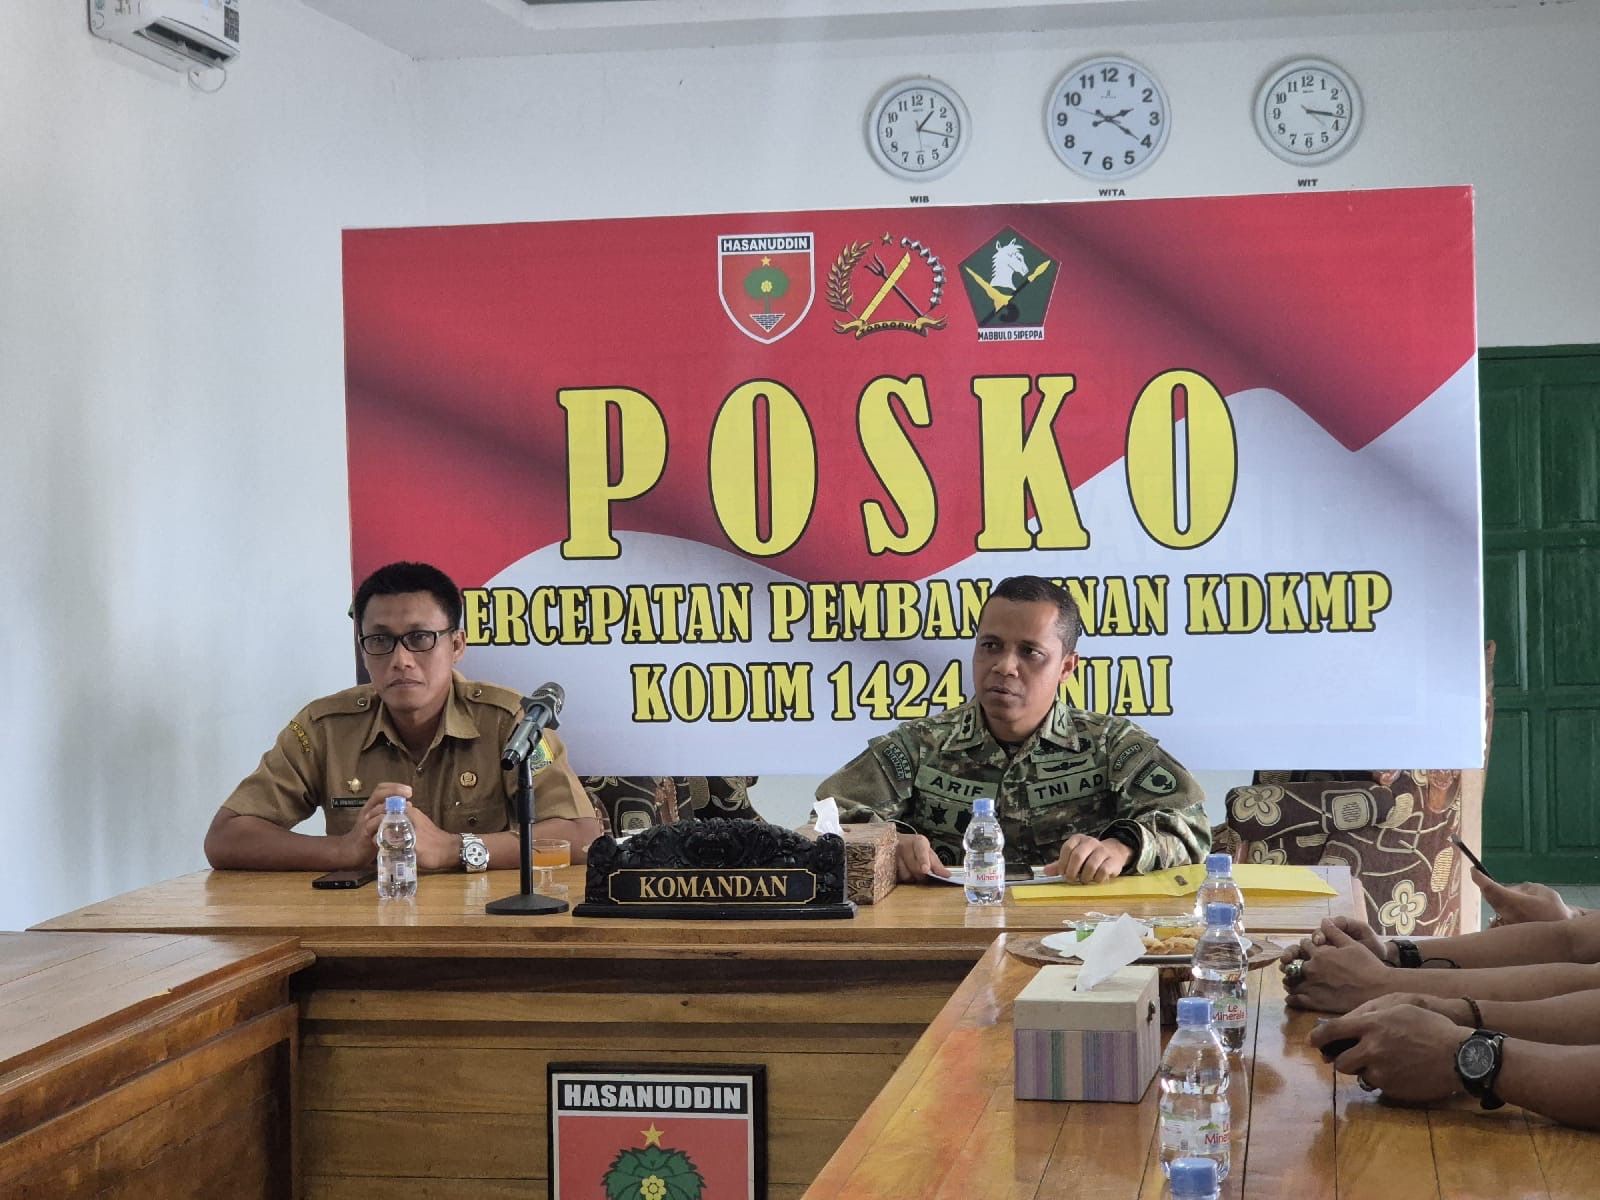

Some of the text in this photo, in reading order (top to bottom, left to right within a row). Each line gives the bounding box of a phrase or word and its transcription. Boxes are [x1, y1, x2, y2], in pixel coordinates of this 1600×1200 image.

[1100, 67, 1119, 82] 12
[1128, 73, 1135, 87] 1
[1080, 75, 1094, 89] 11
[1287, 81, 1298, 93] 11
[1301, 75, 1314, 87] 12
[1320, 78, 1326, 90] 1
[1064, 92, 1082, 106] 10
[1142, 88, 1153, 103] 2
[1276, 92, 1287, 104] 10
[1330, 88, 1338, 100] 2
[898, 100, 907, 112] 11
[911, 95, 923, 107] 12
[930, 97, 935, 109] 1
[939, 107, 947, 118] 2
[1273, 108, 1281, 120] 9
[1336, 103, 1344, 115] 3
[888, 112, 898, 123] 10
[1057, 112, 1068, 127] 9
[1149, 111, 1160, 126] 3
[945, 121, 953, 133] 3
[1278, 123, 1286, 134] 8
[1331, 119, 1339, 131] 4
[885, 127, 893, 138] 9
[1320, 131, 1329, 143] 5
[941, 137, 949, 148] 4
[1064, 134, 1075, 149] 8
[1140, 133, 1152, 149] 4
[1289, 134, 1297, 145] 7
[1305, 136, 1312, 149] 6
[890, 141, 898, 153] 8
[901, 151, 909, 162] 7
[917, 154, 925, 165] 6
[932, 148, 939, 160] 5
[1082, 151, 1093, 166] 7
[1124, 150, 1135, 165] 5
[1102, 156, 1113, 170] 6
[1297, 178, 1319, 187] WIT
[909, 195, 930, 203] WIB
[1098, 189, 1126, 197] WITA
[723, 237, 808, 251] HASANUDDIN
[978, 330, 1043, 341] MABBULO SIPEPPA
[557, 368, 1239, 561] POSKO
[462, 571, 1392, 646] ERCEPATAN PEMBANNAN KDKMP
[630, 655, 1173, 723] KODIM 1424 NJAI
[930, 775, 984, 797] ARIF
[1034, 773, 1104, 800] TNI AD
[639, 875, 787, 898] KOMANDAN
[1227, 1004, 1238, 1013] Le
[564, 1083, 741, 1110] HASANUDDIN
